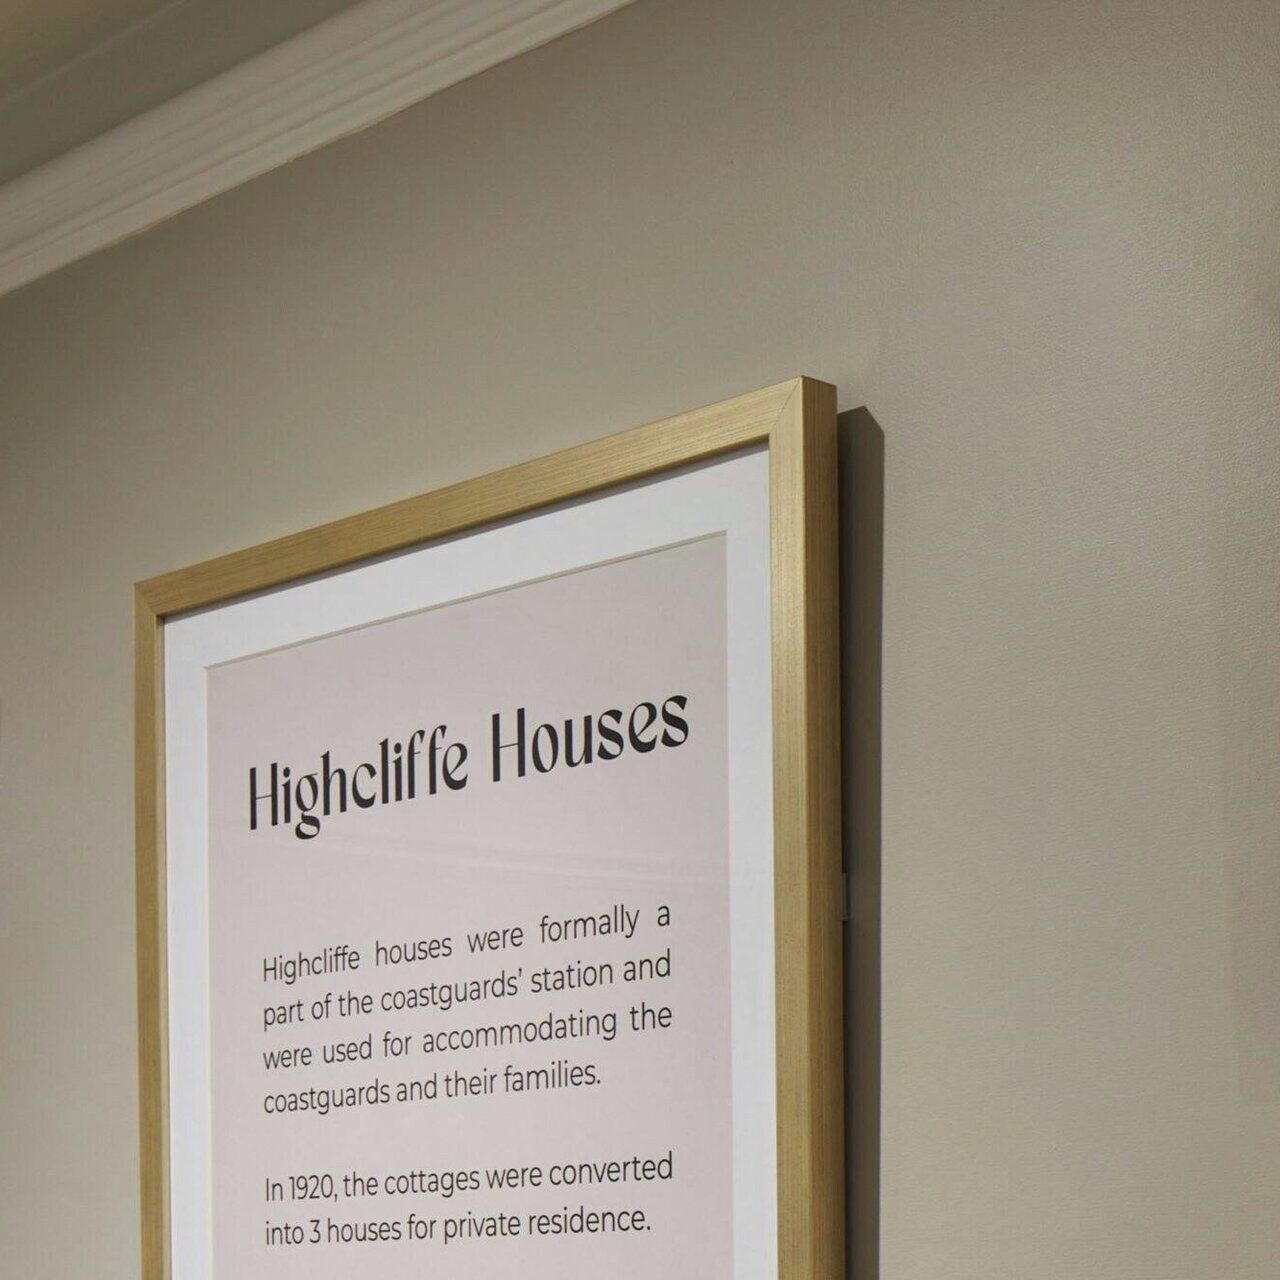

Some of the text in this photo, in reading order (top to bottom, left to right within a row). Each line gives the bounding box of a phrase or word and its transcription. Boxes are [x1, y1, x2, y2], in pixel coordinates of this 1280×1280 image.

[248, 694, 690, 841] Highcliffe Houses
[263, 903, 671, 986] Highcliffe houses were formally a
[263, 999, 305, 1033] part
[310, 992, 333, 1021] of
[337, 989, 374, 1017] the
[530, 959, 614, 994] station
[623, 947, 671, 982] and
[262, 1001, 673, 1070] were used for accommodating the
[263, 1059, 601, 1116] coastguards and their families.
[265, 1149, 673, 1203] In 1920, the cottages were converted
[265, 1204, 651, 1246] into 3 houses for private residence.
